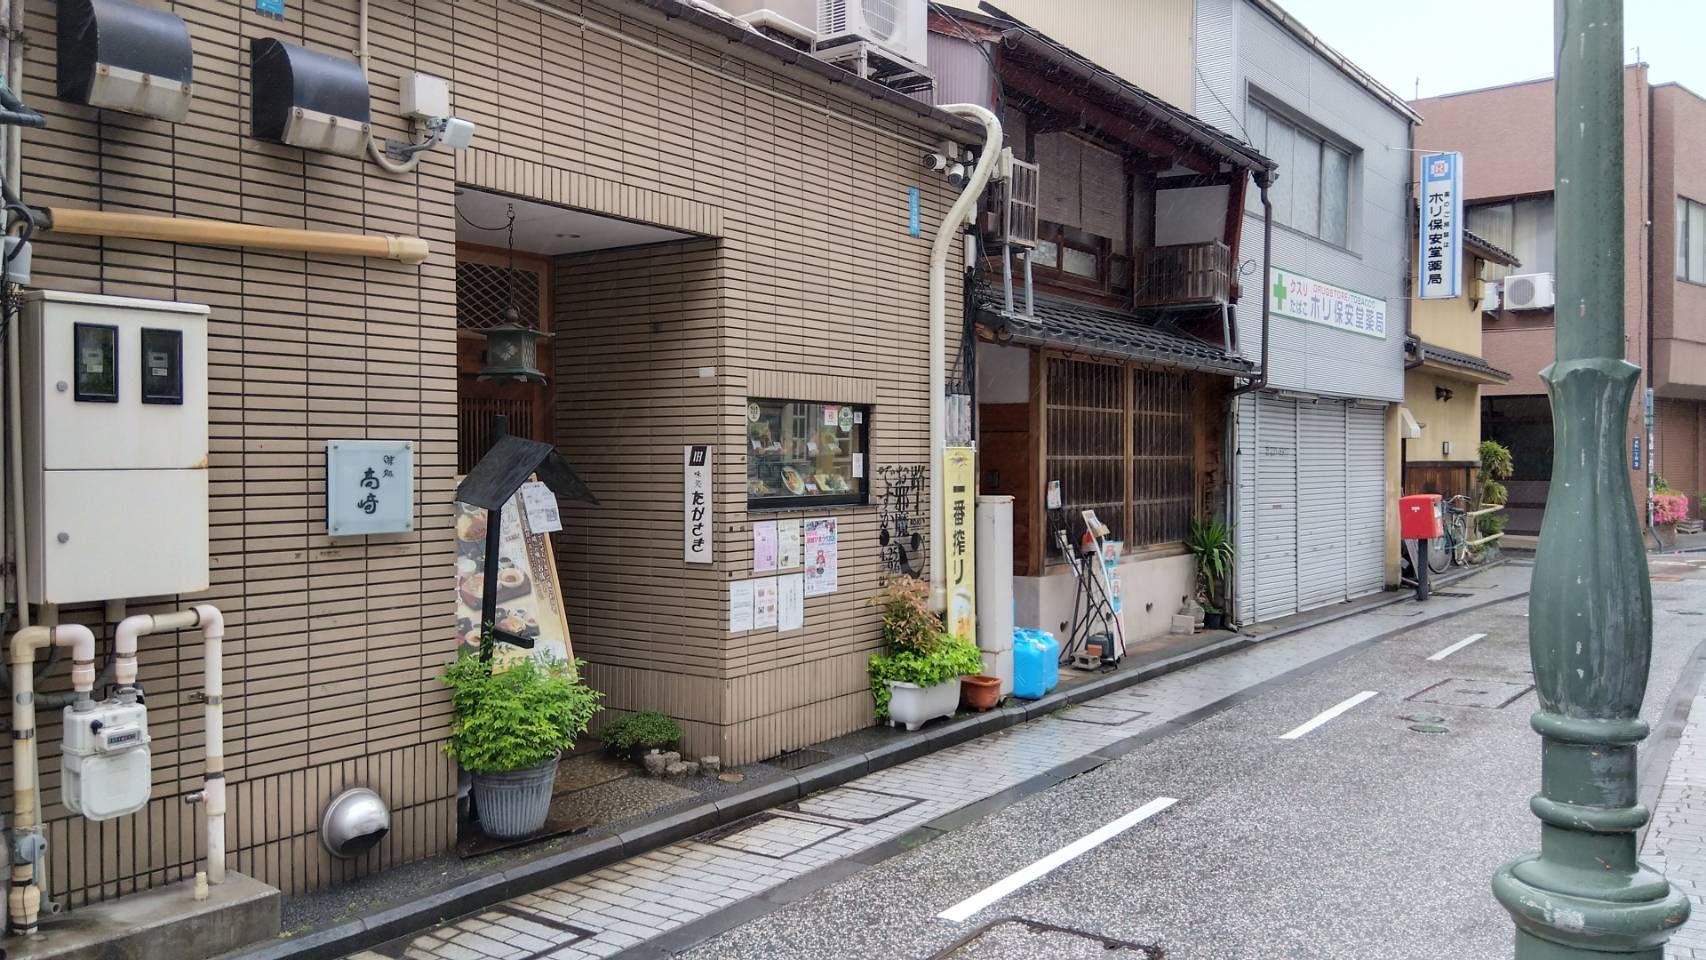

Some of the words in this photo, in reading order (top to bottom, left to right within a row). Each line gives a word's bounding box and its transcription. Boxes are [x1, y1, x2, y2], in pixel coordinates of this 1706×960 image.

[1428, 192, 1444, 286] ホリ保安堂薬局
[1290, 279, 1308, 297] クスリ
[1310, 294, 1384, 334] ホリ保安堂薬局
[953, 485, 965, 585] 一番搾り
